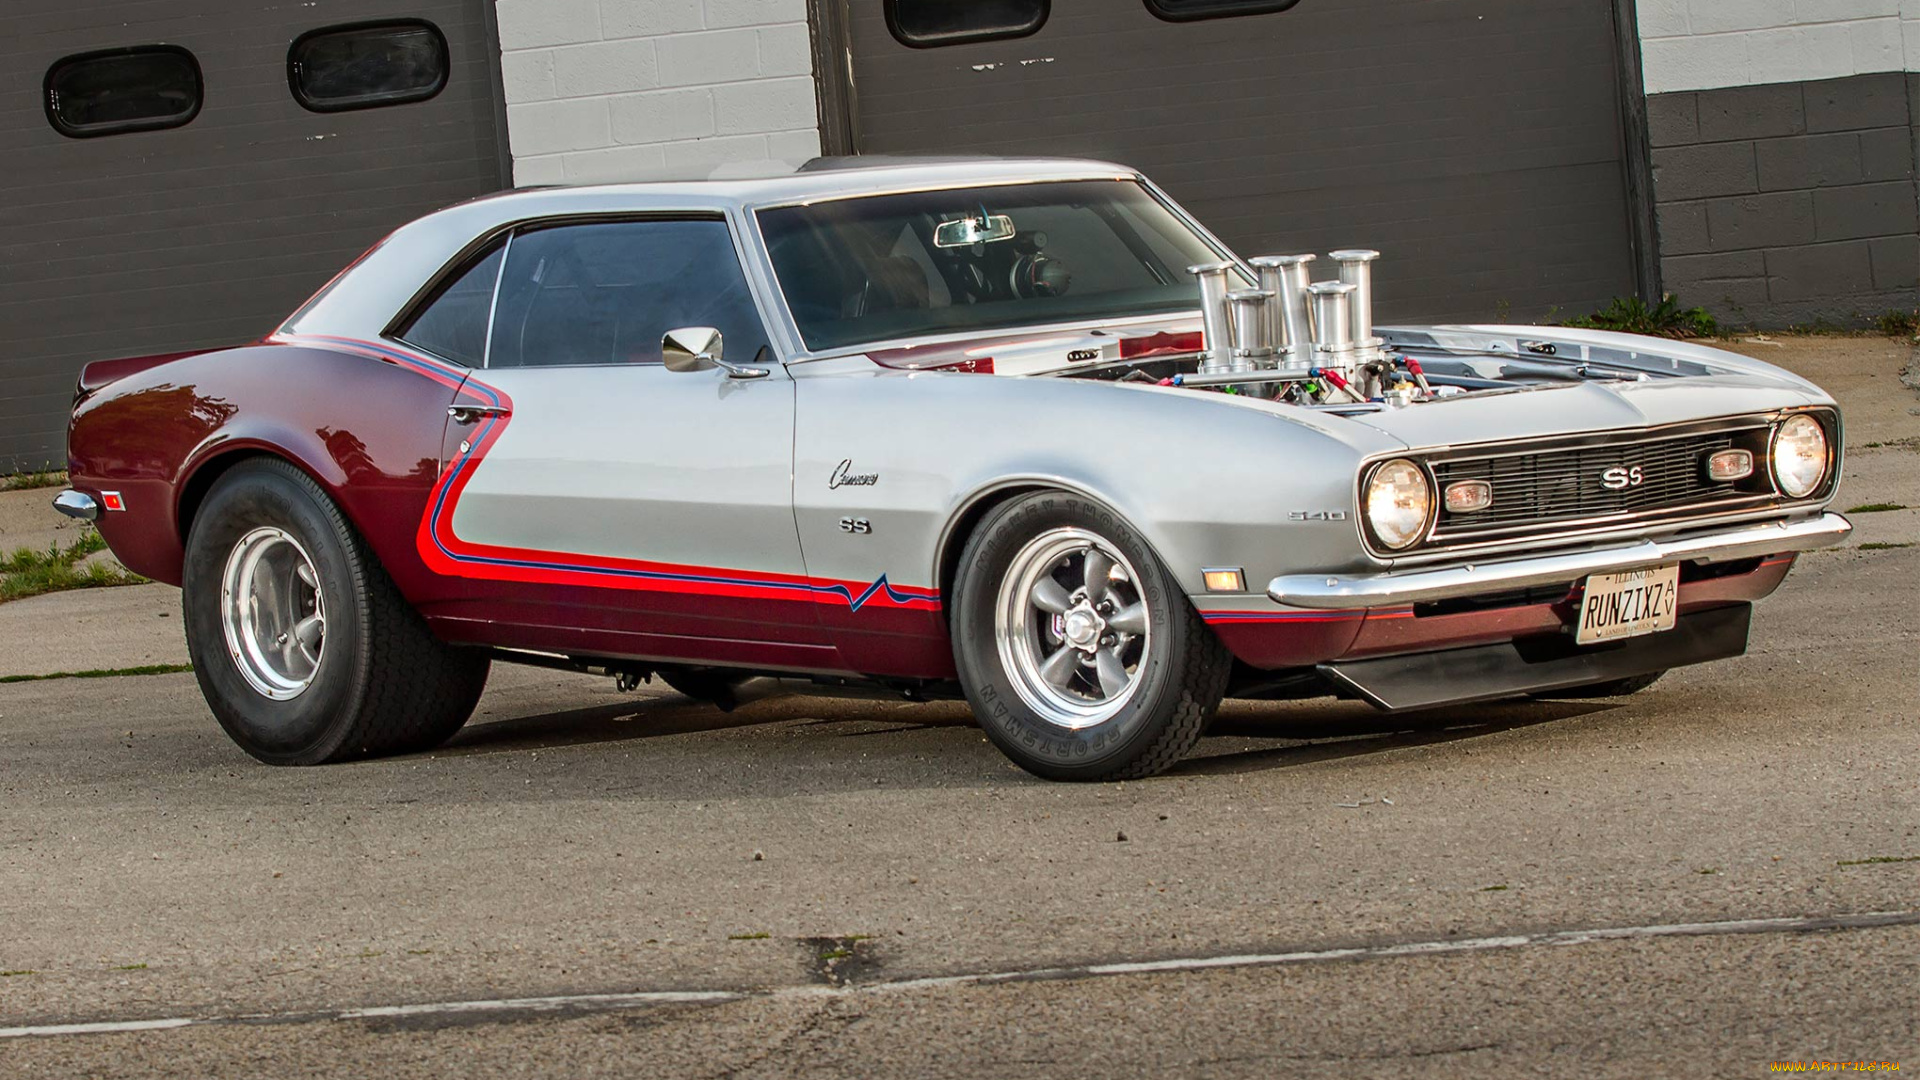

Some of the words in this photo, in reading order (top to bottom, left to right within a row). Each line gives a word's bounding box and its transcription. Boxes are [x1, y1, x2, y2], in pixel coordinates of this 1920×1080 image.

[1602, 466, 1643, 489] SS
[838, 517, 872, 534] SS
[976, 500, 1055, 572] MICKEY
[1066, 500, 1165, 626] THOMPSON
[1614, 569, 1655, 585] ILLINOIS
[1585, 583, 1663, 629] RUNZIXZ
[980, 684, 1121, 757] SPORTSMAN
